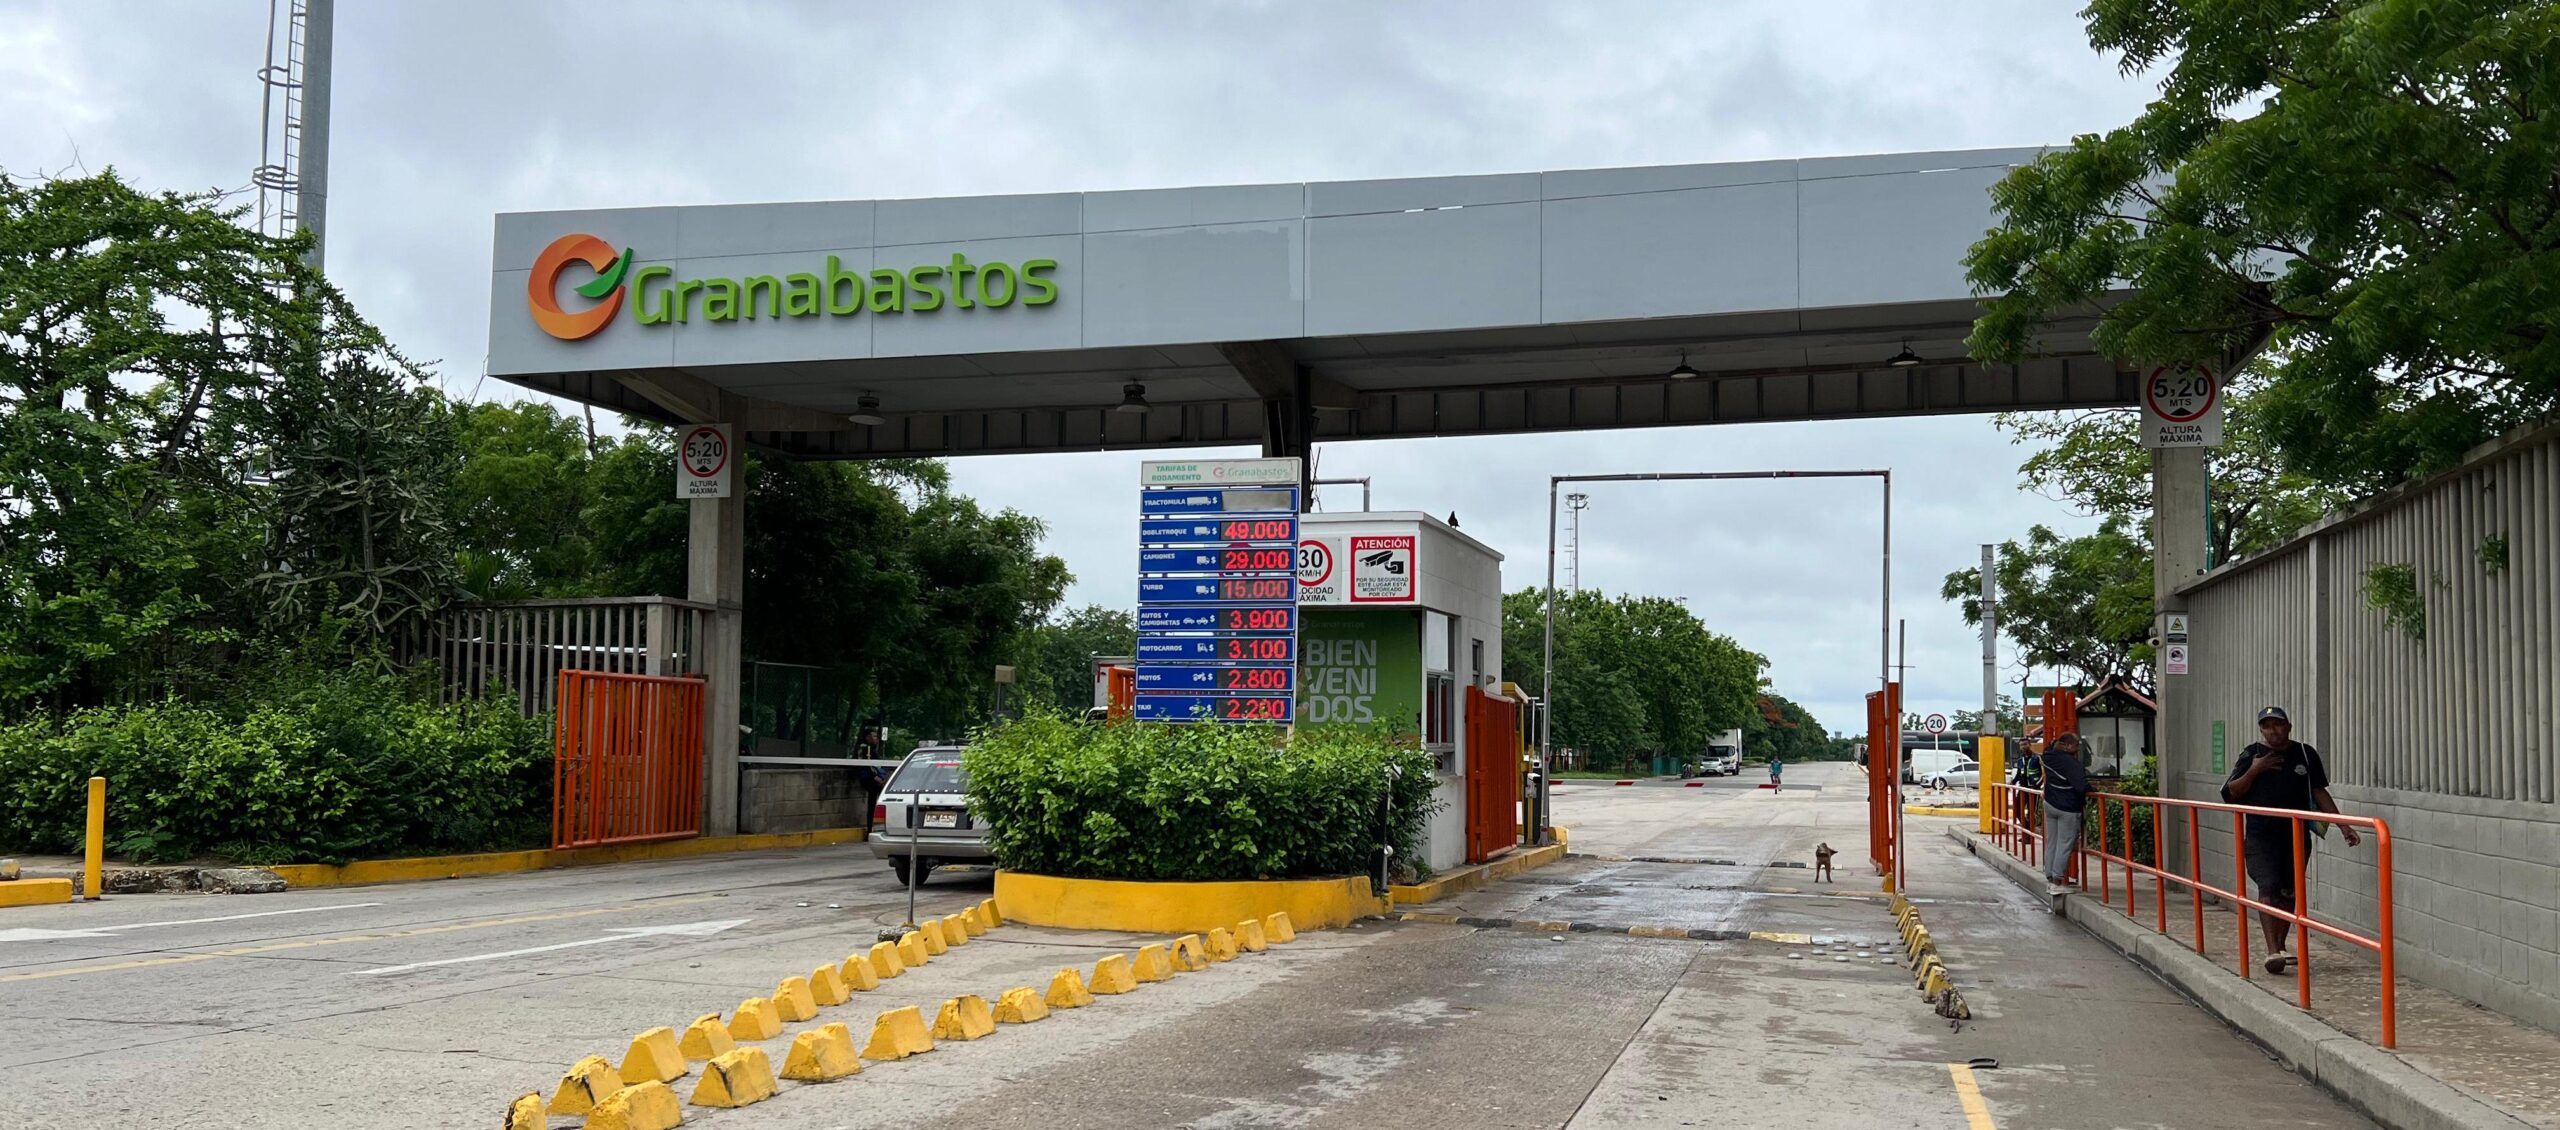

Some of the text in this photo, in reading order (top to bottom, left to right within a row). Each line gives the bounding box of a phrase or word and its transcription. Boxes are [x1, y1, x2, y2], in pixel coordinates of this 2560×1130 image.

[631, 253, 1058, 325] Granabastos
[2154, 377, 2208, 398] 5,20
[2169, 398, 2191, 406] MTS
[2160, 425, 2202, 434] ALTURA
[687, 441, 722, 458] 5,20
[1227, 466, 1288, 478] Granabastos
[1144, 498, 1186, 506] TRACTOMULA
[1142, 528, 1187, 536] DOBLETROQUE
[1225, 521, 1290, 539] 49.000
[1356, 538, 1410, 548] ATENCIÓN
[1225, 551, 1289, 569] 29.000
[1299, 549, 1323, 568] 30
[1225, 580, 1288, 598] 15.000
[1230, 610, 1288, 629] 3.900
[1229, 640, 1287, 659] 3.100
[1306, 639, 1377, 666] BIEN
[1228, 669, 1286, 688] 2.800
[1304, 667, 1377, 695] VENI
[1309, 695, 1373, 723] DOS
[1930, 719, 1942, 729] 20
